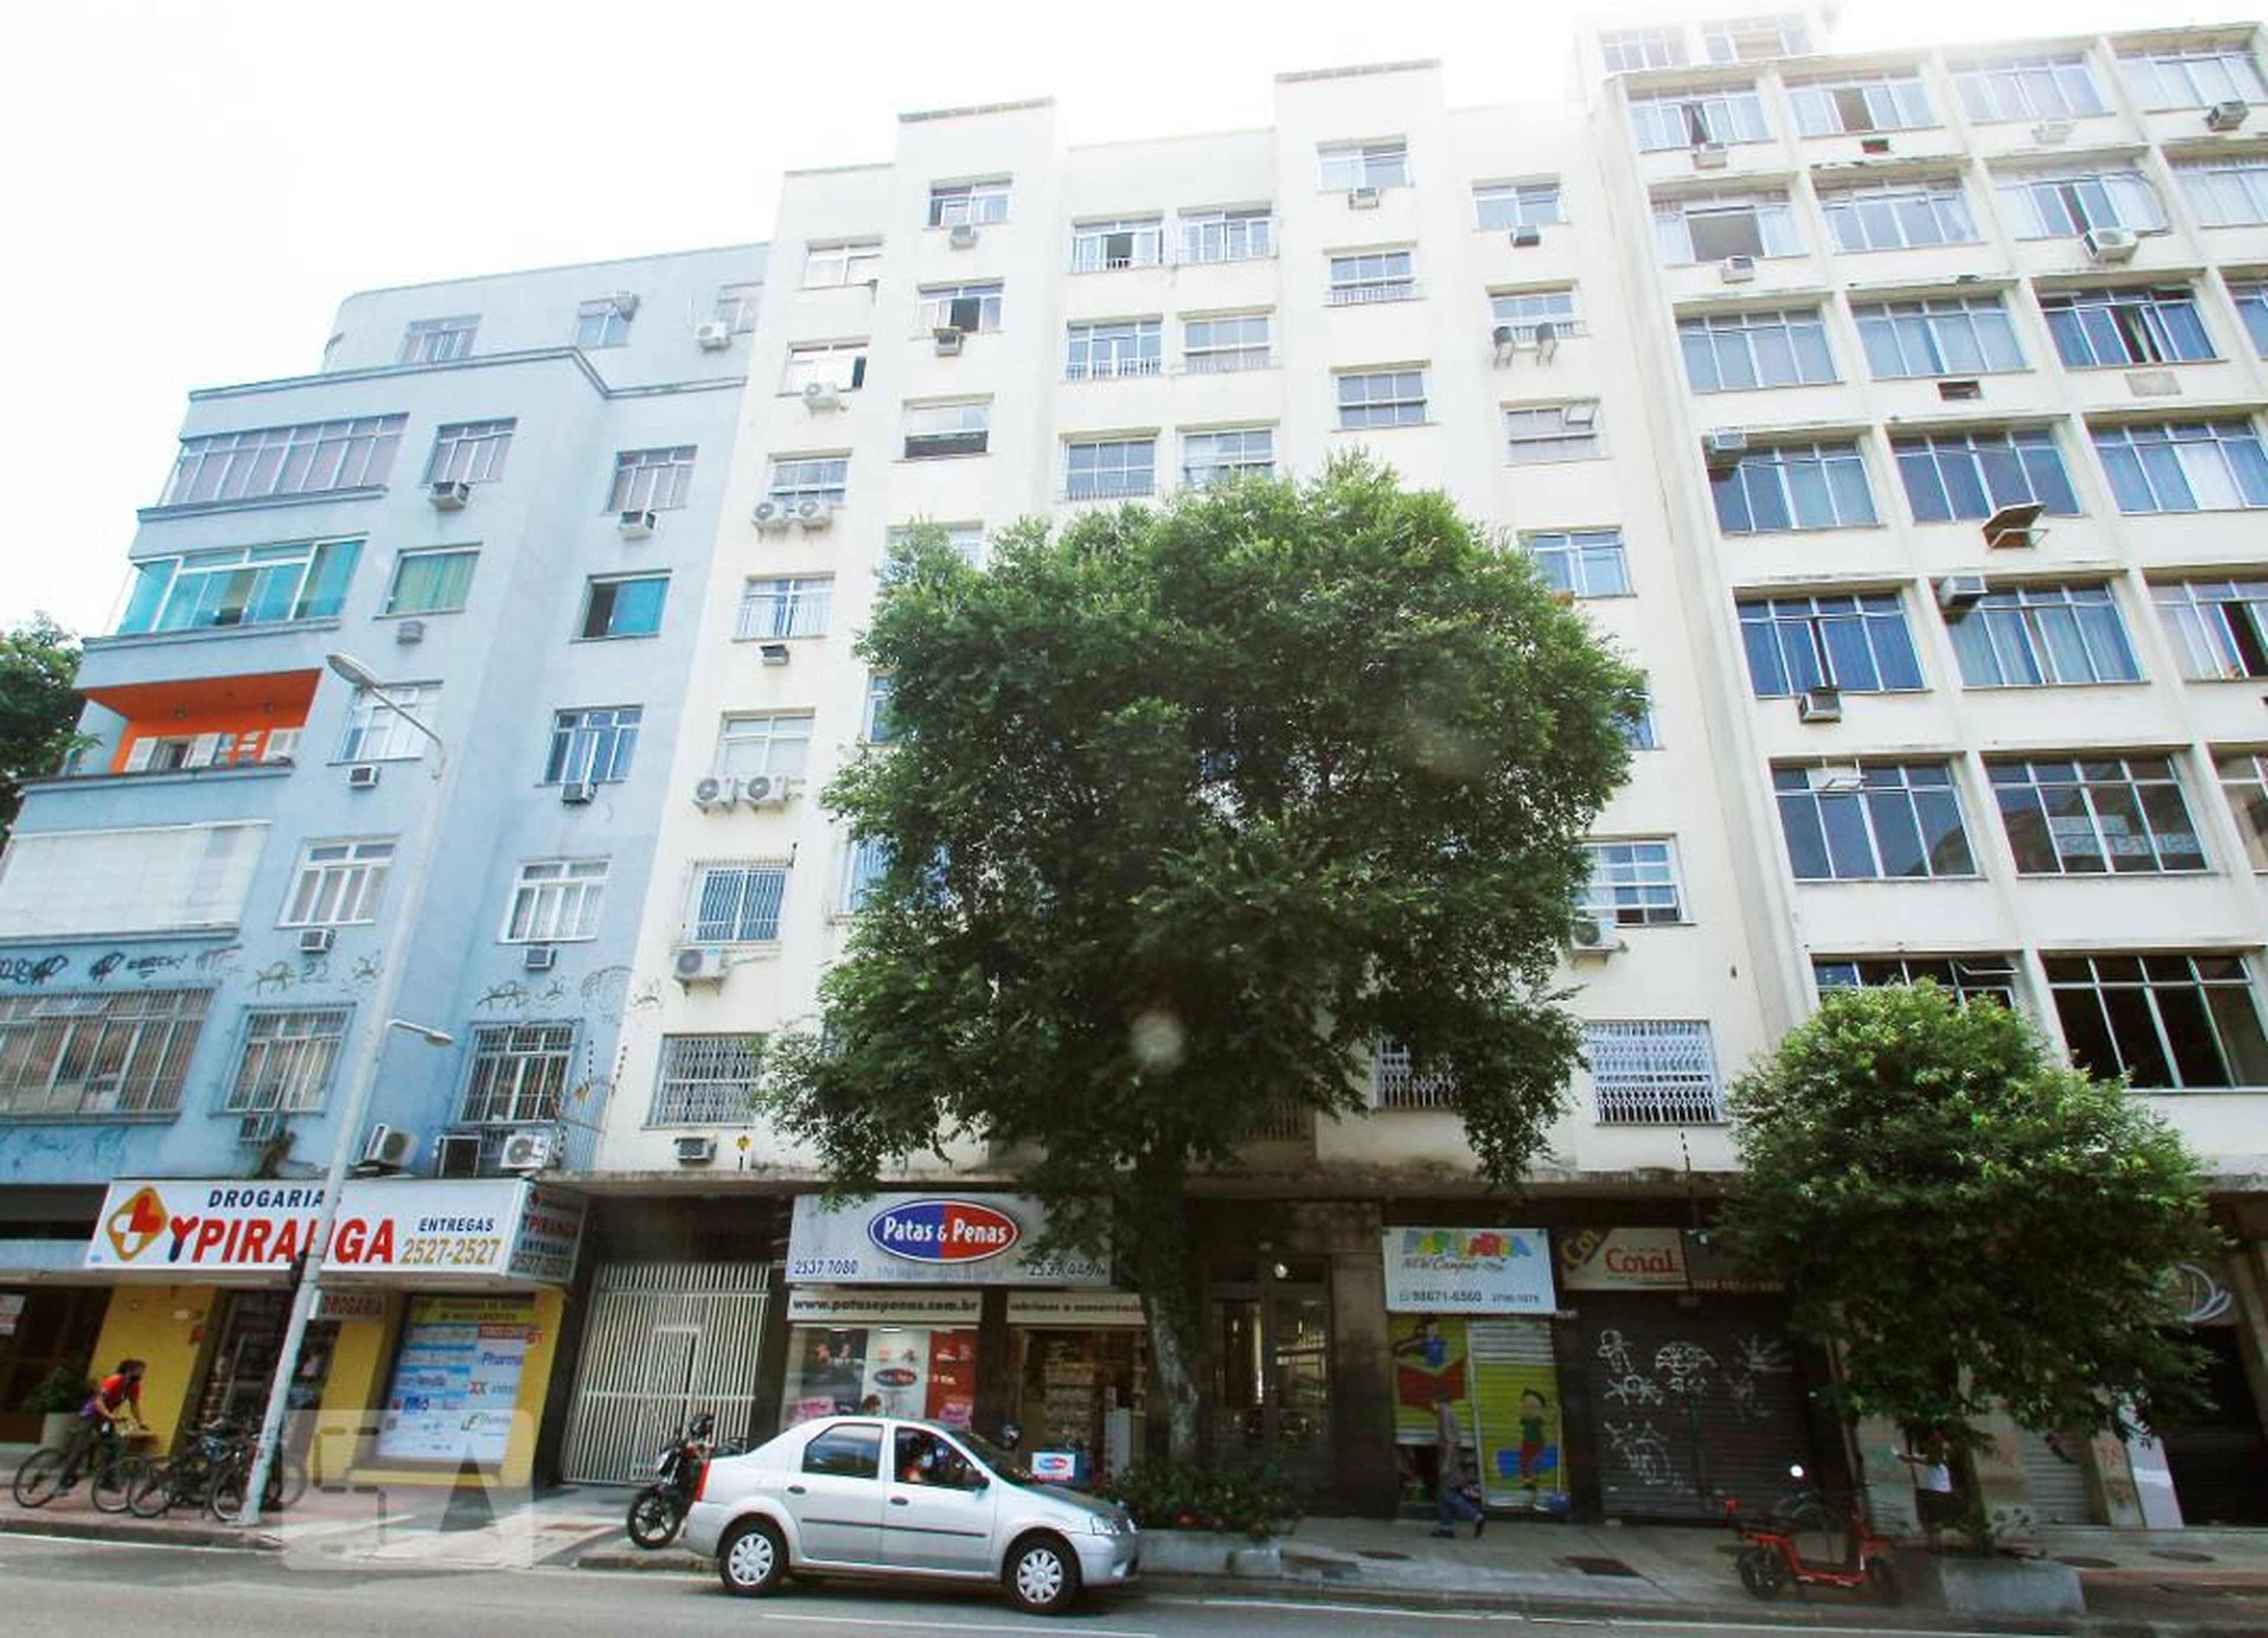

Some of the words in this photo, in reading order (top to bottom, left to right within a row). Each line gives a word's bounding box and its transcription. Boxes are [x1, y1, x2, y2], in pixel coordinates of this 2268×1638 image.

[208, 1189, 342, 1208] DROGARIA
[419, 1218, 495, 1232] ENTREGAS
[883, 1217, 933, 1241] Patas
[937, 1227, 947, 1241] &
[952, 1217, 1007, 1243] Penas
[400, 1239, 501, 1264] 2527-2527
[1605, 1248, 1673, 1272] Coral
[794, 1260, 825, 1275] 2537
